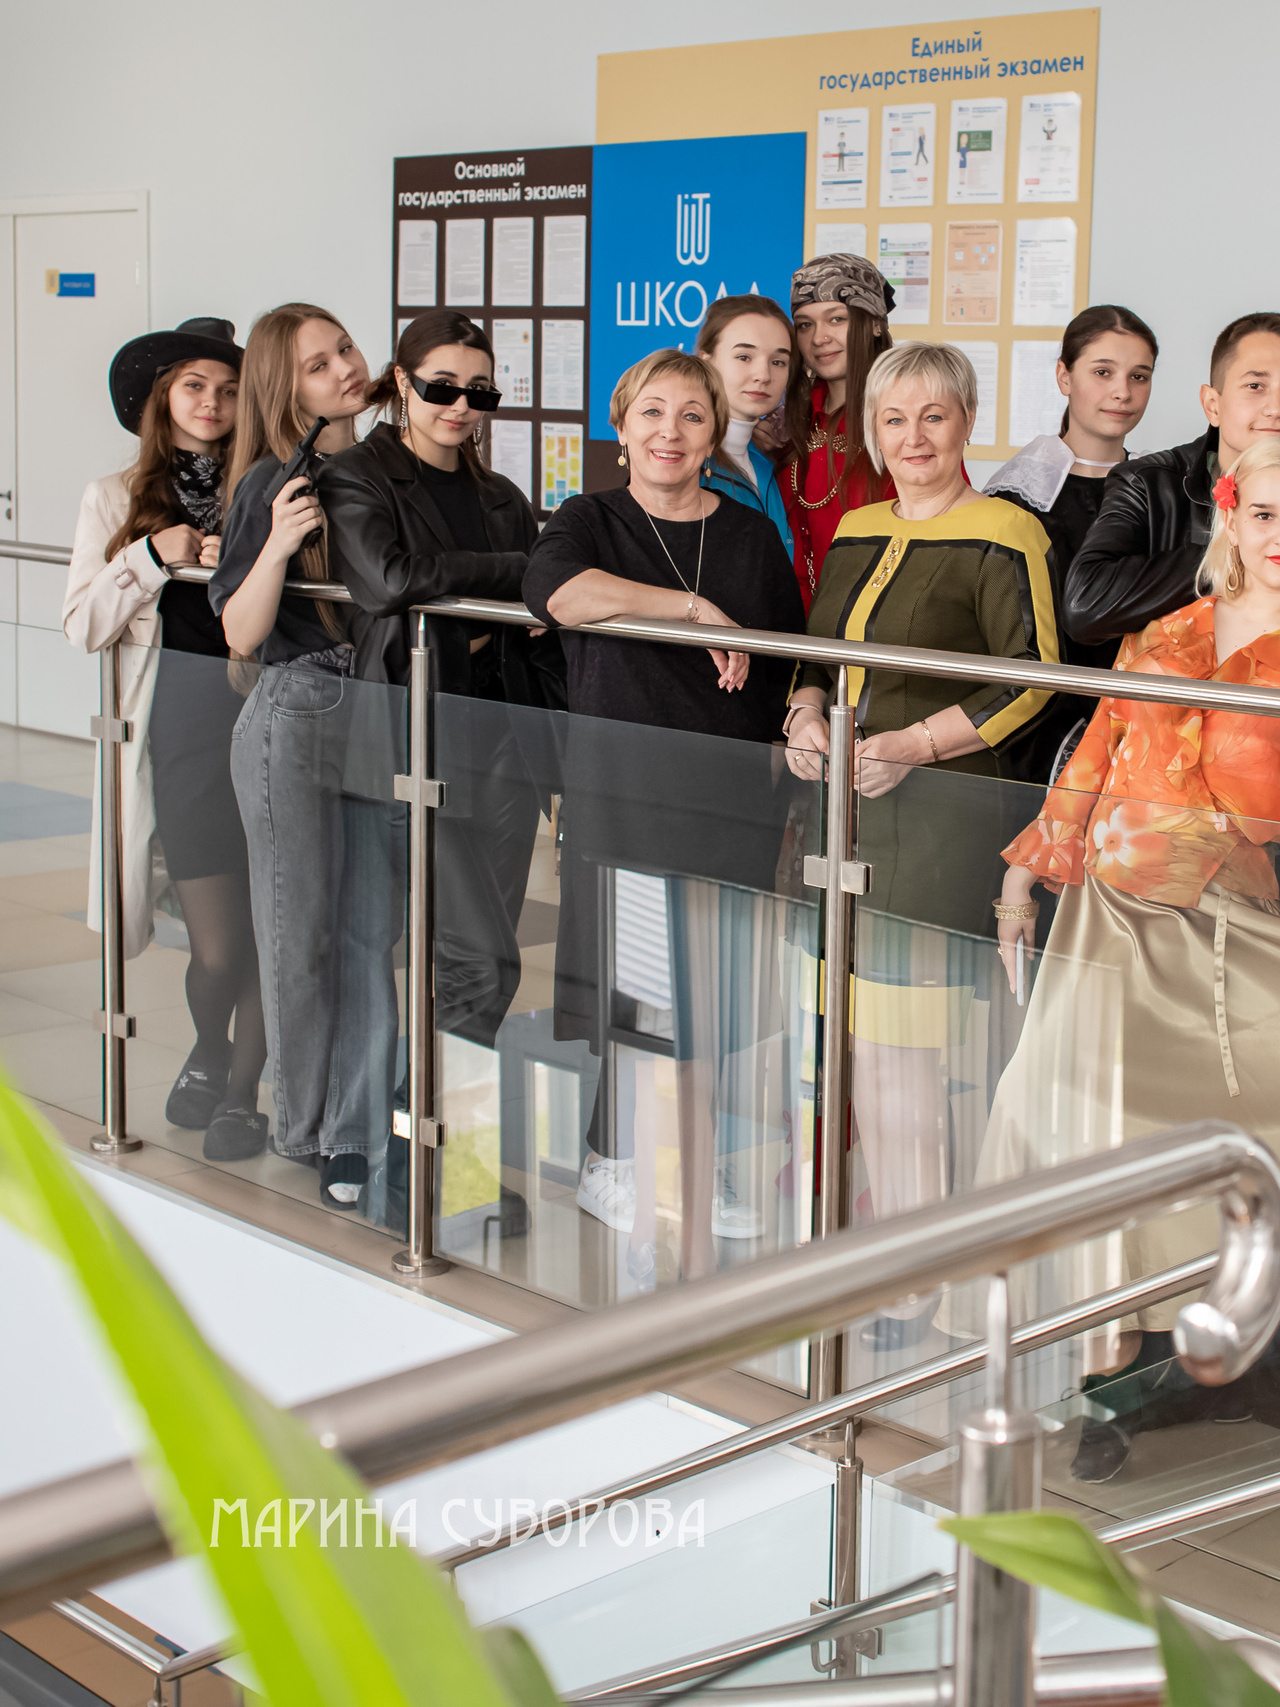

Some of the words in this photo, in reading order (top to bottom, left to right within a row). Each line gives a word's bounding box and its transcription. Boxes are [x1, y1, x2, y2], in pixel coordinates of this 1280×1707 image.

[911, 31, 983, 58] Единый
[819, 57, 990, 92] государственный
[996, 55, 1085, 78] экзамен
[454, 157, 526, 181] Основной
[398, 182, 521, 209] государственный
[524, 183, 587, 201] экзамен
